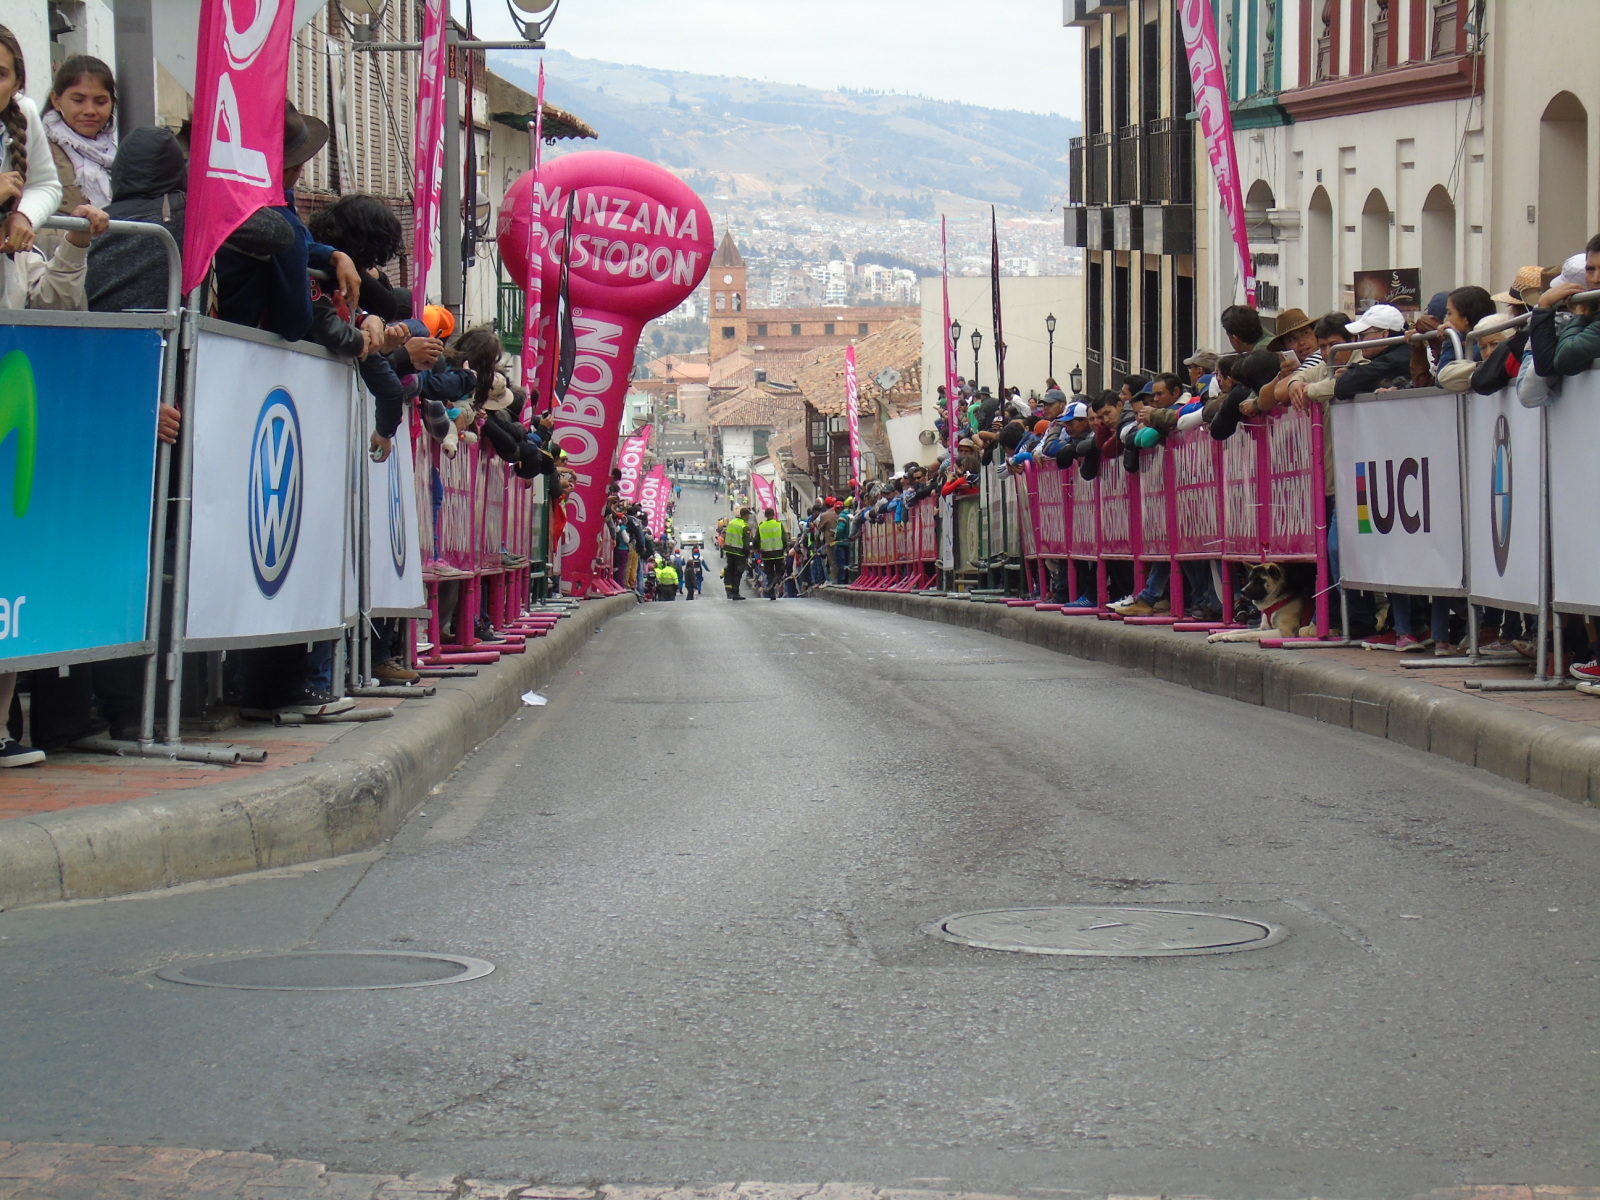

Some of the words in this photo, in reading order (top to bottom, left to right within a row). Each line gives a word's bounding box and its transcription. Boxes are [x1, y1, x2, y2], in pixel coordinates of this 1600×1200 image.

[533, 182, 699, 241] MANZANA
[526, 224, 697, 287] POSTOBON
[1271, 475, 1312, 537] POSTOBON
[1368, 457, 1431, 535] UCI
